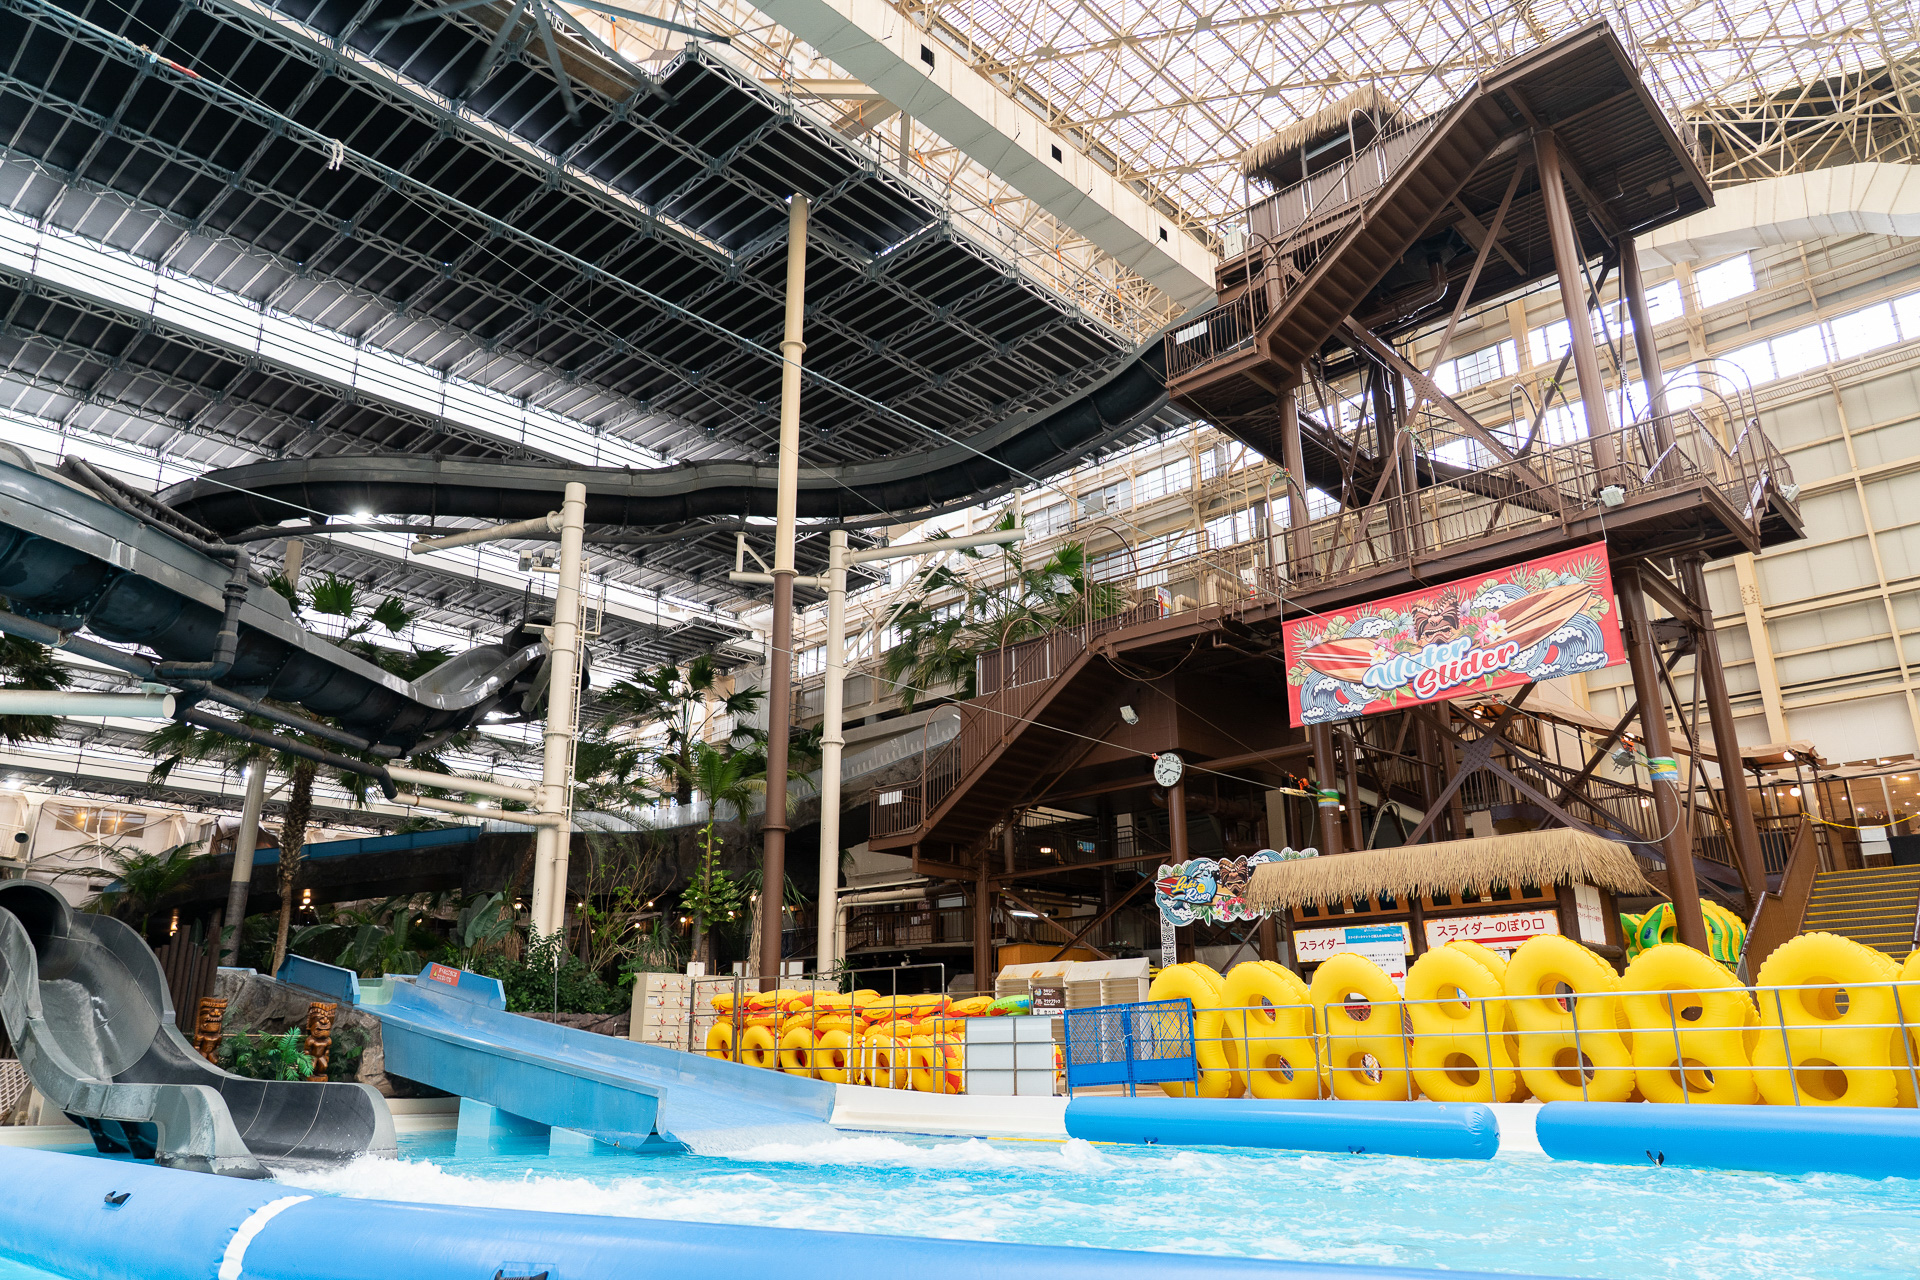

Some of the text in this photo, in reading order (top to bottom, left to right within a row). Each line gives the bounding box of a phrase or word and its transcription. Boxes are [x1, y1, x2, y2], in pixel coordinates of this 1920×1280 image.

[1365, 640, 1468, 686] Water
[1416, 645, 1515, 695] Slider
[1170, 875, 1198, 893] Laki
[1185, 887, 1211, 901] River
[1436, 918, 1545, 937] スライダーのぼり口
[1299, 938, 1346, 951] スライダー
